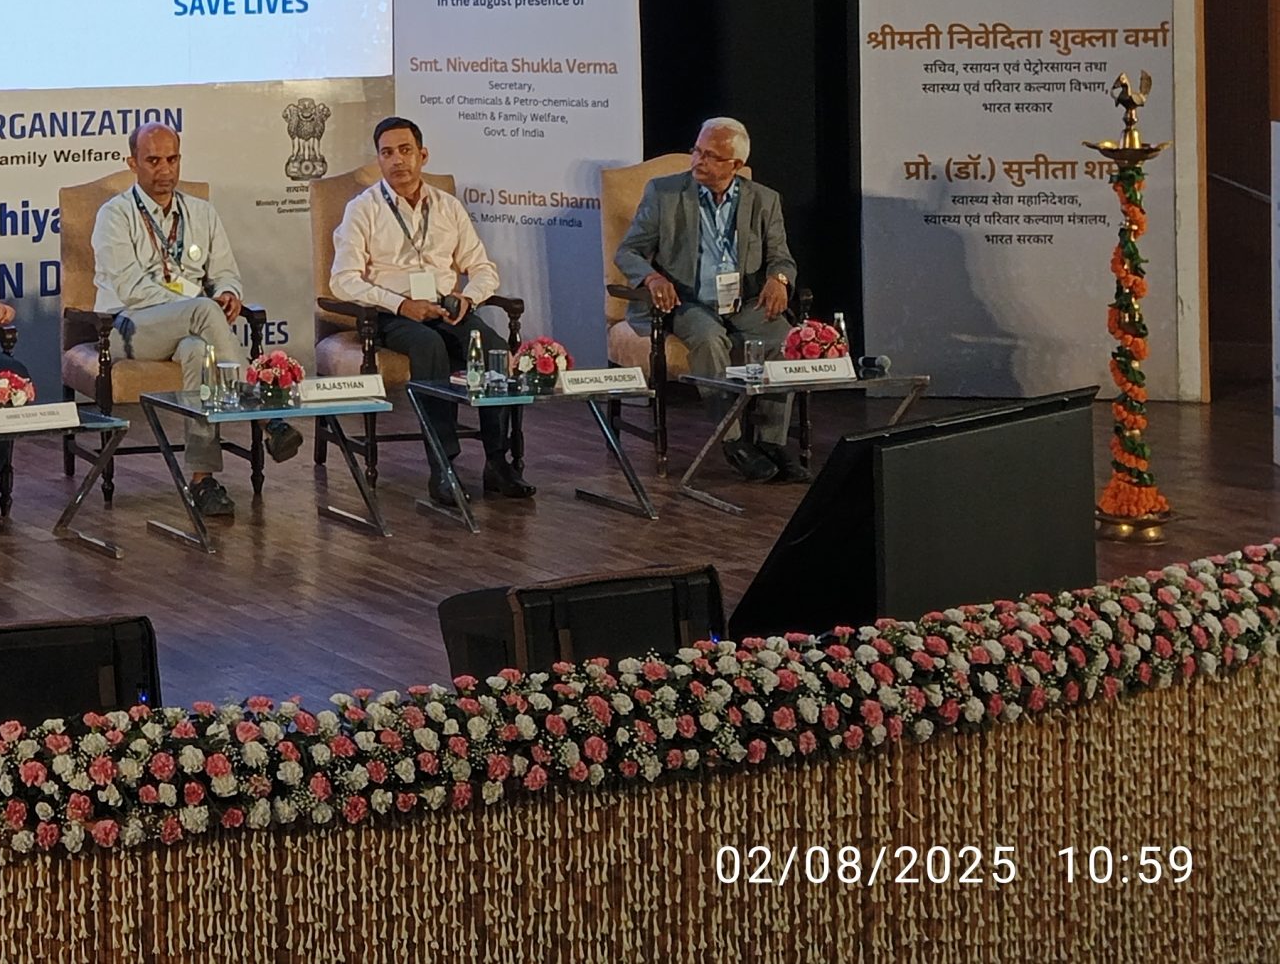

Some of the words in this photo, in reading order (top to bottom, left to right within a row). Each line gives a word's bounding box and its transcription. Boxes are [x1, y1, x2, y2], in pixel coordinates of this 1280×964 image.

[867, 23, 943, 50] श्रीमती
[947, 23, 1043, 50] निवेदिता
[1049, 29, 1119, 56] शुक्ला
[1123, 21, 1170, 47] वर्मा
[410, 57, 443, 72] Smt.
[446, 57, 509, 73] Nivedita
[511, 57, 563, 74] Shukla
[565, 58, 618, 74] Verma
[53, 149, 125, 163] Welfare,
[783, 366, 810, 374] TAMIL
[811, 364, 836, 372] NADU
[315, 381, 364, 391] RAJASTHAN
